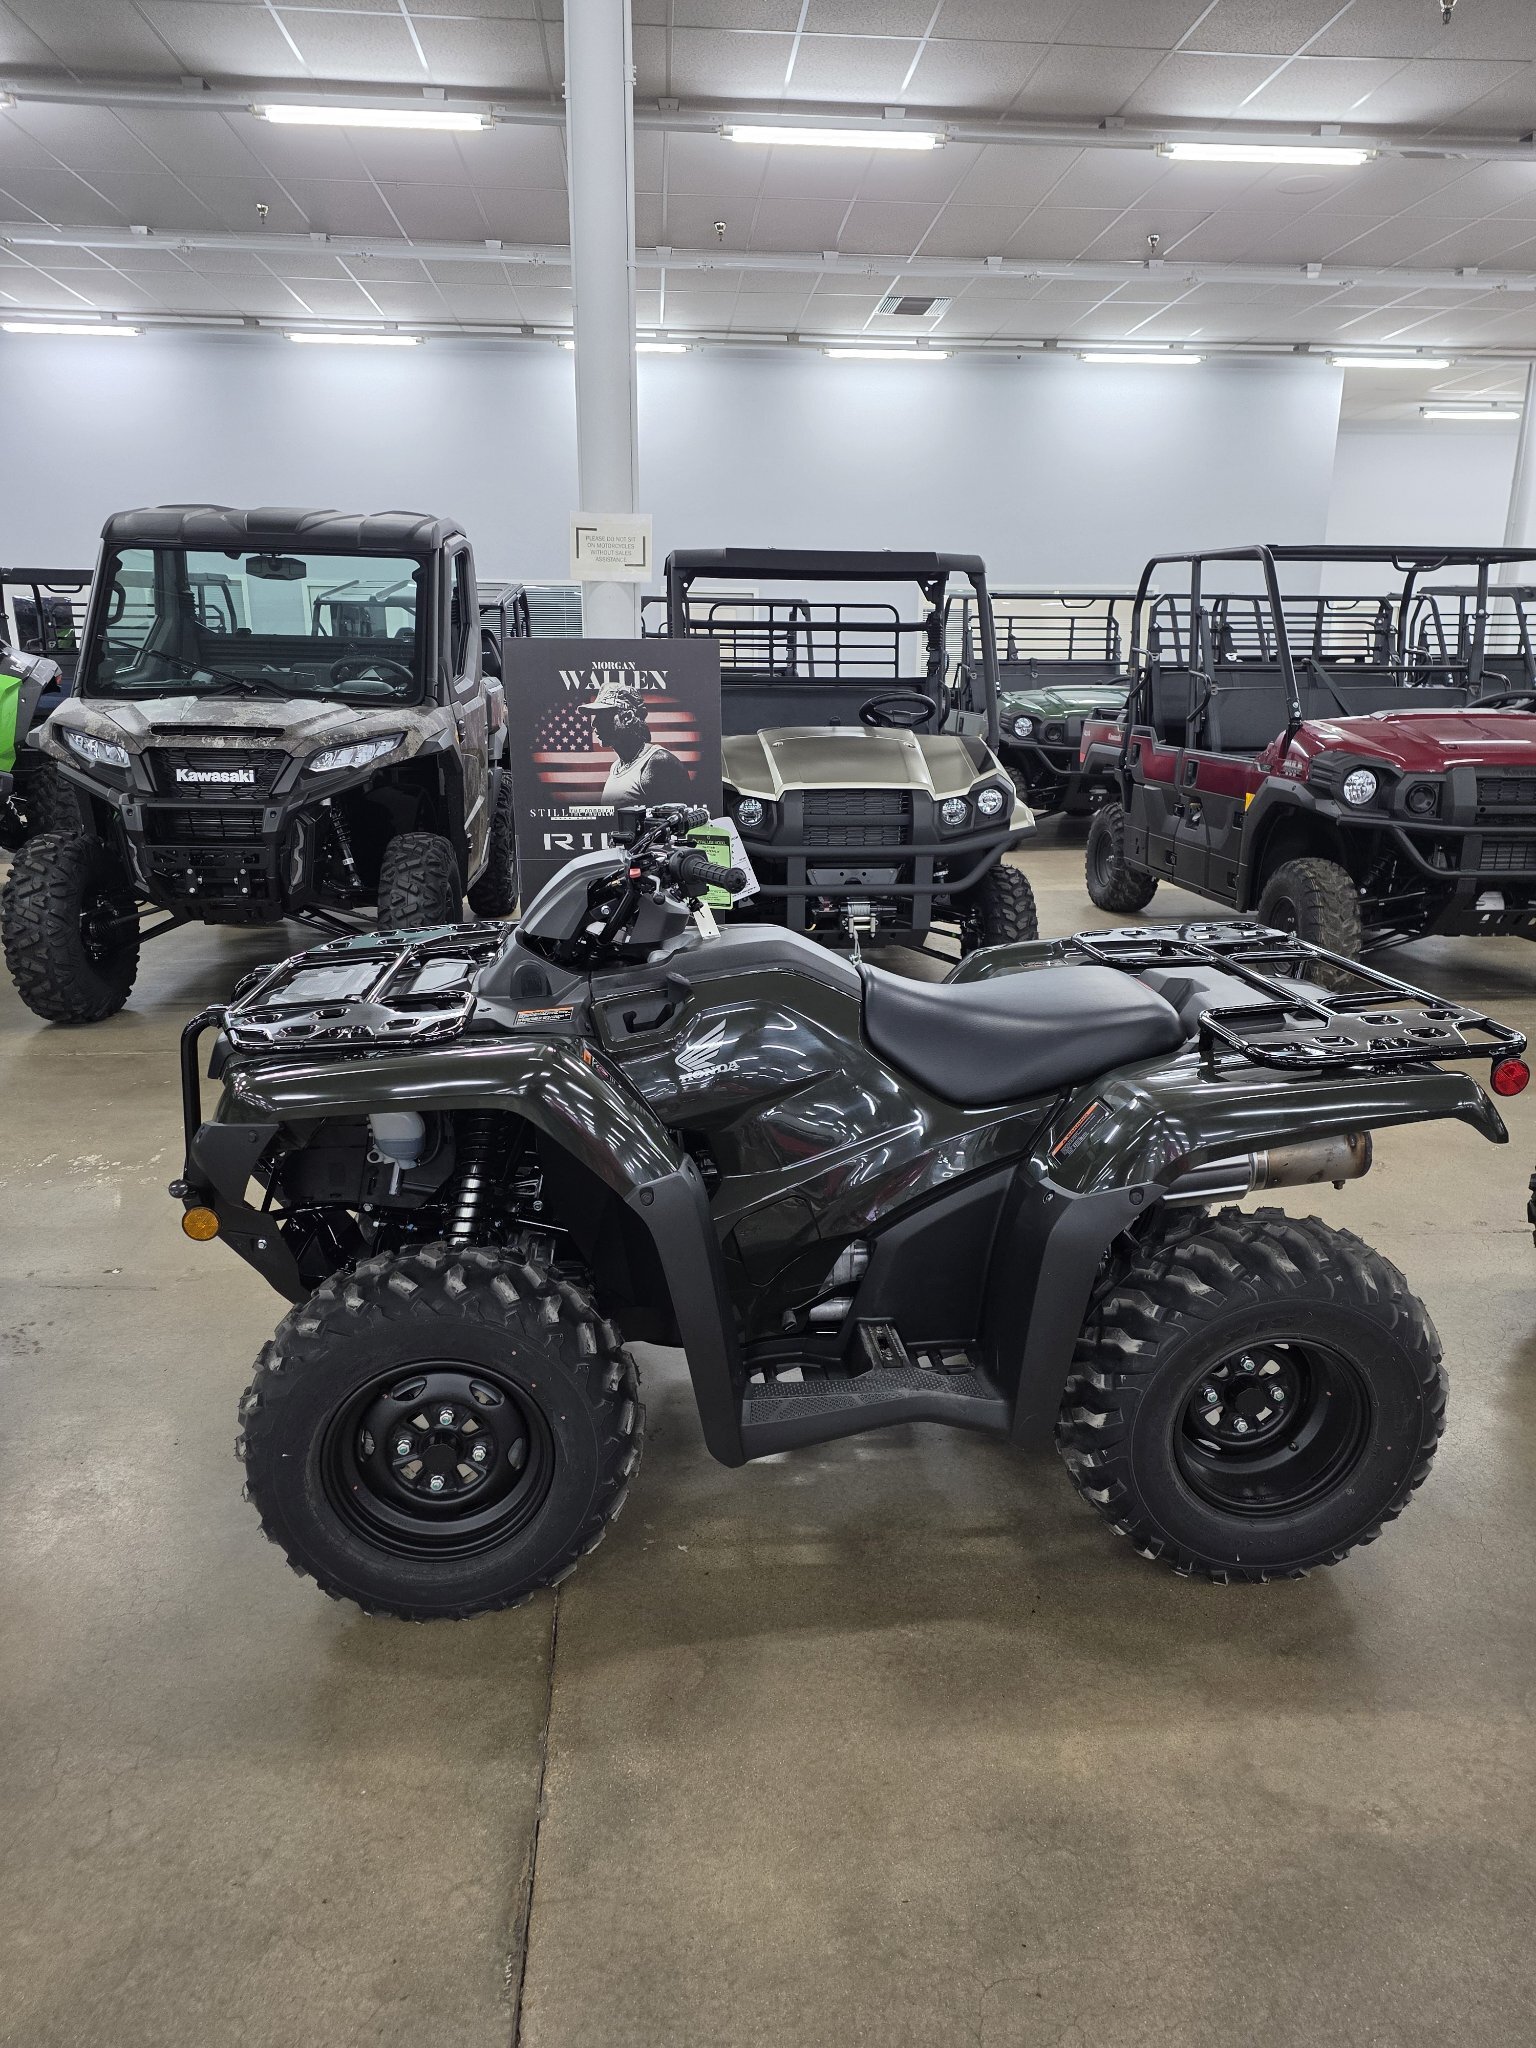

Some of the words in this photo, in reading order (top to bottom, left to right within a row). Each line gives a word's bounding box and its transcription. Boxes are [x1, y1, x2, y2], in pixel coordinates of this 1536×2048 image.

[591, 661, 636, 670] MORGAN
[558, 670, 669, 691] WALLEN
[175, 768, 255, 783] Kawasaki
[529, 808, 569, 817] STILL
[678, 1060, 741, 1083] HONDA
